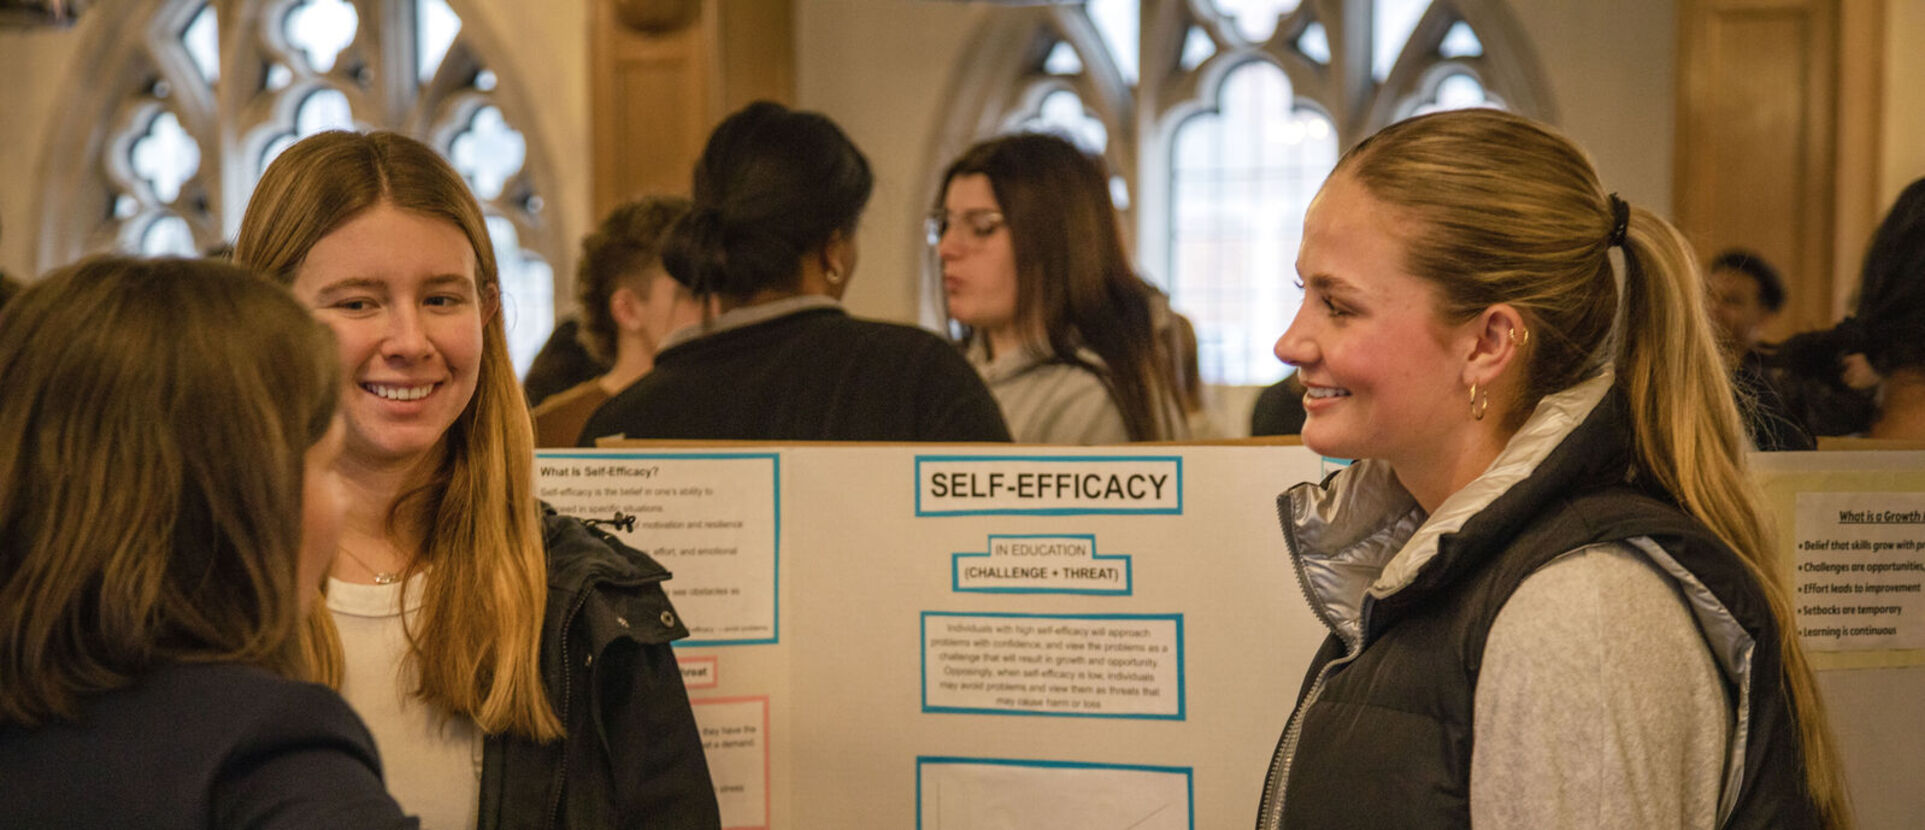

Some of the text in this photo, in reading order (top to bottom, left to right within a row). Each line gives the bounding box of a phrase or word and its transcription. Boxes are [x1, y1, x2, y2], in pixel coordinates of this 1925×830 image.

[540, 466, 569, 477] What
[584, 466, 659, 479] Self-Efficacy?
[595, 488, 602, 496] is
[604, 487, 618, 496] the
[620, 487, 643, 496] belief
[645, 488, 652, 496] in
[654, 487, 677, 496] one's
[679, 487, 702, 497] ability
[704, 487, 713, 496] to
[930, 472, 1168, 500] SELF-EFFICACY
[588, 504, 618, 514] specific
[1839, 509, 1866, 521] What
[1867, 510, 1874, 521] is
[1884, 509, 1921, 521] Growth
[643, 519, 684, 529] motivation
[687, 519, 704, 529] and
[706, 518, 743, 529] resilience
[680, 547, 695, 556] and
[995, 544, 1087, 557] IN EDUCATION
[1804, 540, 1829, 550] Belief
[1831, 540, 1849, 550] that
[1851, 540, 1871, 550] skills
[1873, 542, 1894, 553] grow
[1896, 540, 1915, 550] with
[964, 567, 1049, 580] (CHALLENGE
[1063, 567, 1119, 582] THREAT)
[1804, 562, 1850, 575] Challenges
[1851, 564, 1865, 572] are
[1804, 582, 1921, 595] Effort leads to improvement
[1803, 605, 1902, 617] Setbacks are temporary
[946, 623, 1151, 638] Individuals with high self-efficacy will approach
[1803, 627, 1896, 639] Learning is continuous
[930, 638, 970, 648] problems
[973, 639, 989, 648] with
[1046, 641, 1063, 650] and
[1065, 642, 1085, 650] view
[1087, 642, 1102, 650] the
[1104, 643, 1145, 653] problems
[1148, 645, 1159, 653] as
[938, 652, 980, 664] challenge
[983, 653, 999, 662] that
[1002, 653, 1016, 662] will
[1019, 654, 1042, 663] result
[1045, 655, 1053, 663] in
[1055, 656, 1085, 667] growth
[1088, 657, 1105, 666] and
[997, 668, 1020, 677] when
[1023, 668, 1075, 680] self-efficacy
[1078, 671, 1085, 679] is
[1107, 671, 1155, 681] individuals
[939, 682, 1160, 696] may avoid problems and view them as threats that
[996, 697, 1015, 708] may
[1018, 698, 1043, 707] cause
[1046, 699, 1069, 708] harm
[1071, 700, 1081, 708] or
